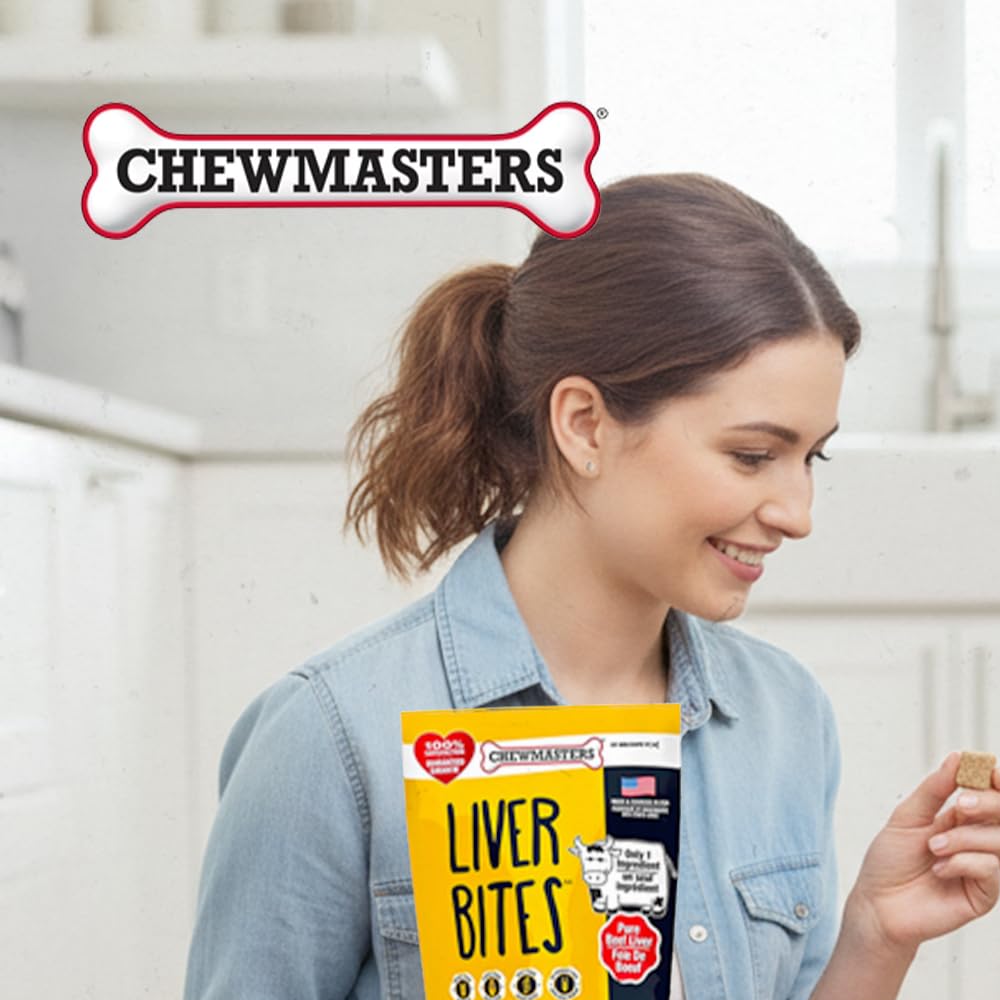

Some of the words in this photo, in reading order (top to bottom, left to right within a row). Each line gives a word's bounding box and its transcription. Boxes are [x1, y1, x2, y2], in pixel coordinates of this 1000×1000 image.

[489, 748, 595, 763] CHEWMASTERS
[447, 797, 560, 873] LIVER
[452, 877, 563, 960] BITES
